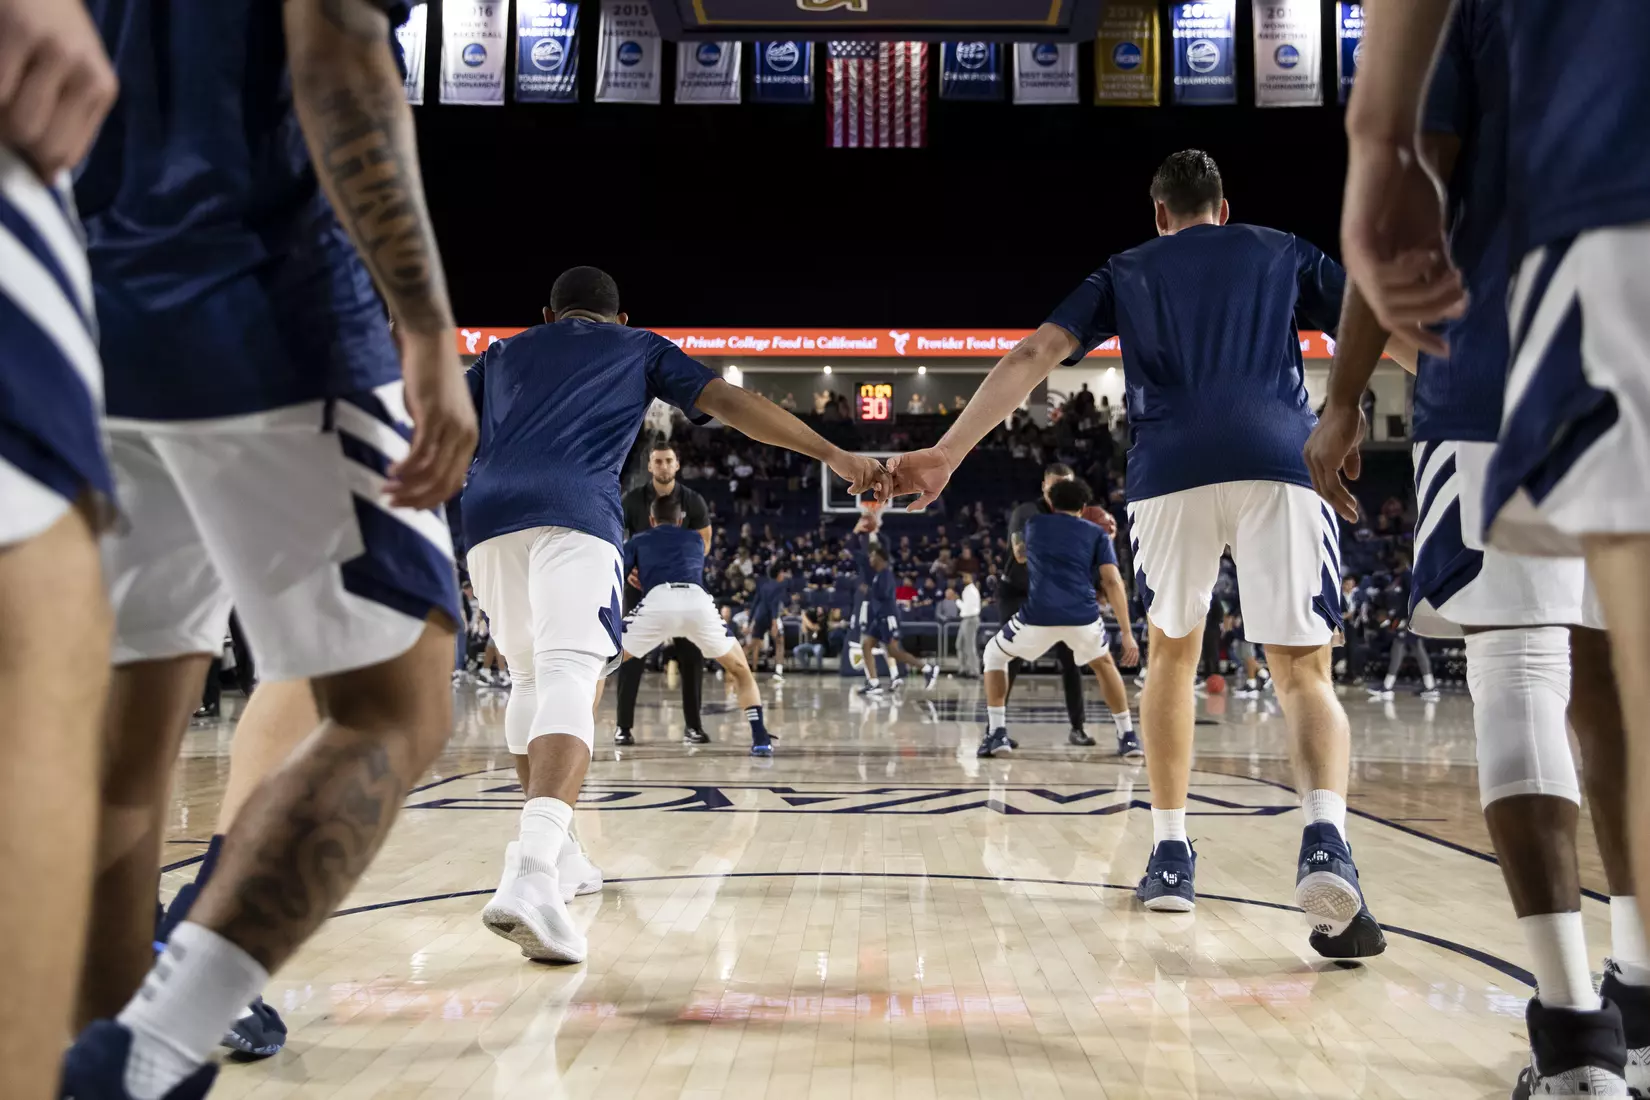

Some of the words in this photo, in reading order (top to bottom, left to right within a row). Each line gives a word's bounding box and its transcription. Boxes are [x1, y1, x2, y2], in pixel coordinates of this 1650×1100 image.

[613, 4, 649, 17] 2015
[1182, 3, 1220, 18] 201
[755, 74, 810, 84] CHAMPIONS
[1173, 76, 1234, 85] CHAMPIONS
[685, 335, 727, 349] Private
[727, 335, 771, 351] College
[771, 335, 801, 349] Food
[803, 335, 816, 349] in
[816, 335, 879, 349] California!
[917, 336, 964, 350] Provider
[966, 336, 996, 350] Food
[861, 397, 889, 420] 30
